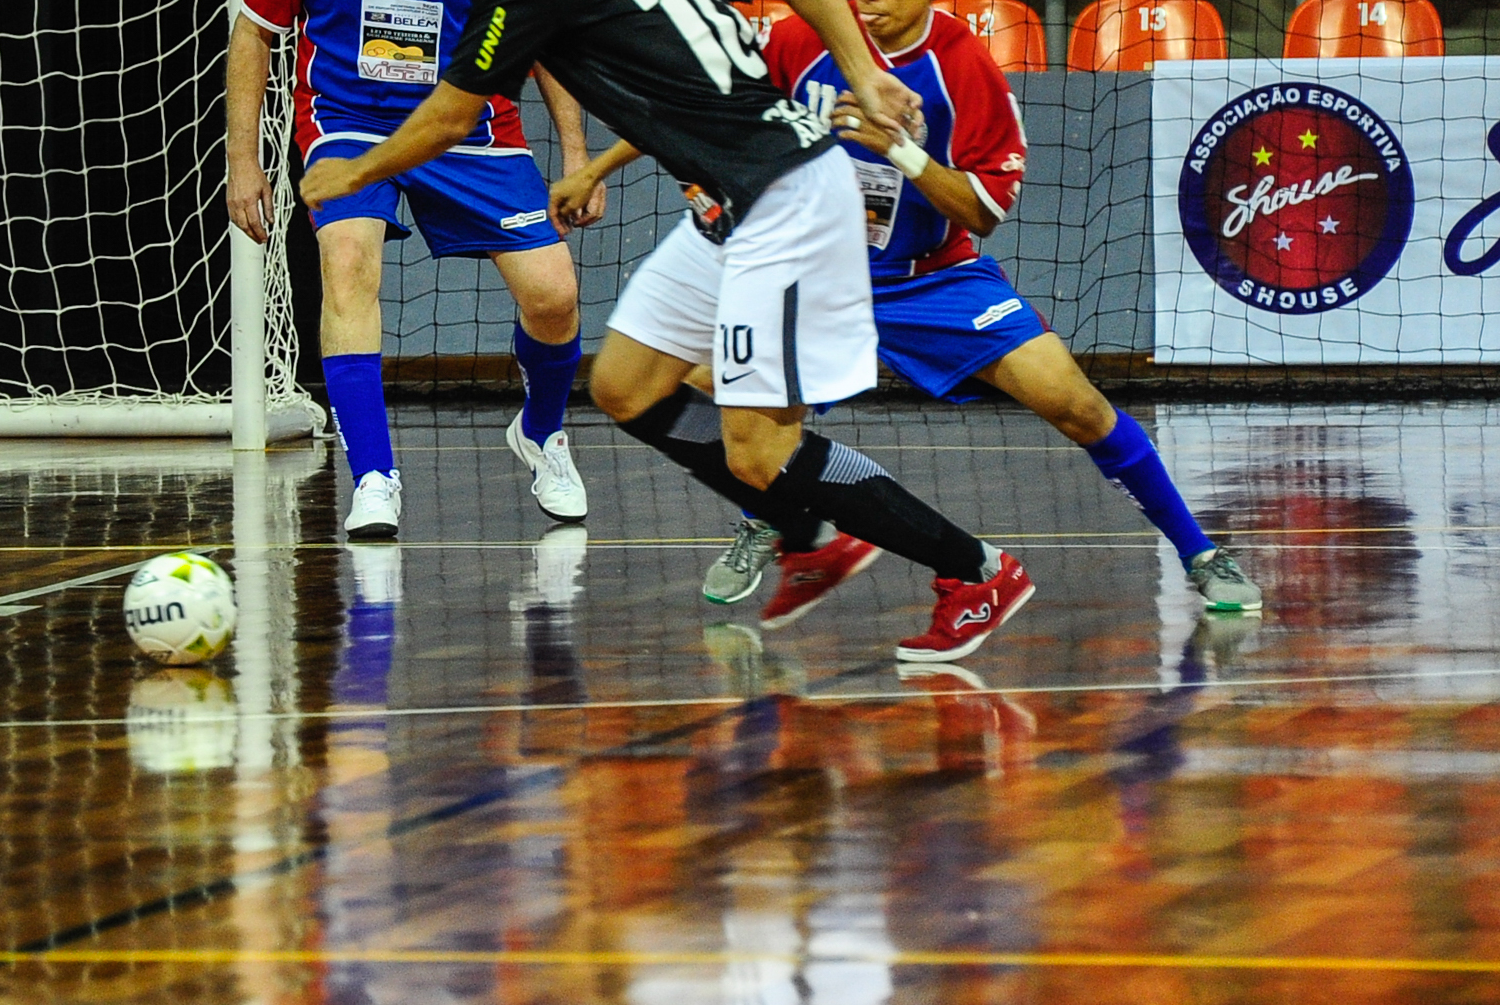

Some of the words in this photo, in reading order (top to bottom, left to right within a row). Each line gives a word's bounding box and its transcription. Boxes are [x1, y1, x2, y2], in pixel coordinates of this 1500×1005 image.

[393, 17, 438, 29] BELÉM
[967, 13, 995, 34] 12
[1139, 7, 1166, 30] 13
[1358, 2, 1386, 25] 14
[474, 7, 507, 72] UNIP
[806, 79, 837, 127] 11
[1189, 86, 1300, 175] ASSOCIAÇÃO
[1307, 89, 1403, 173] ESPORTIVA
[1222, 165, 1379, 238] Shouse
[1237, 277, 1359, 310] SHOUSE
[719, 323, 754, 365] 10
